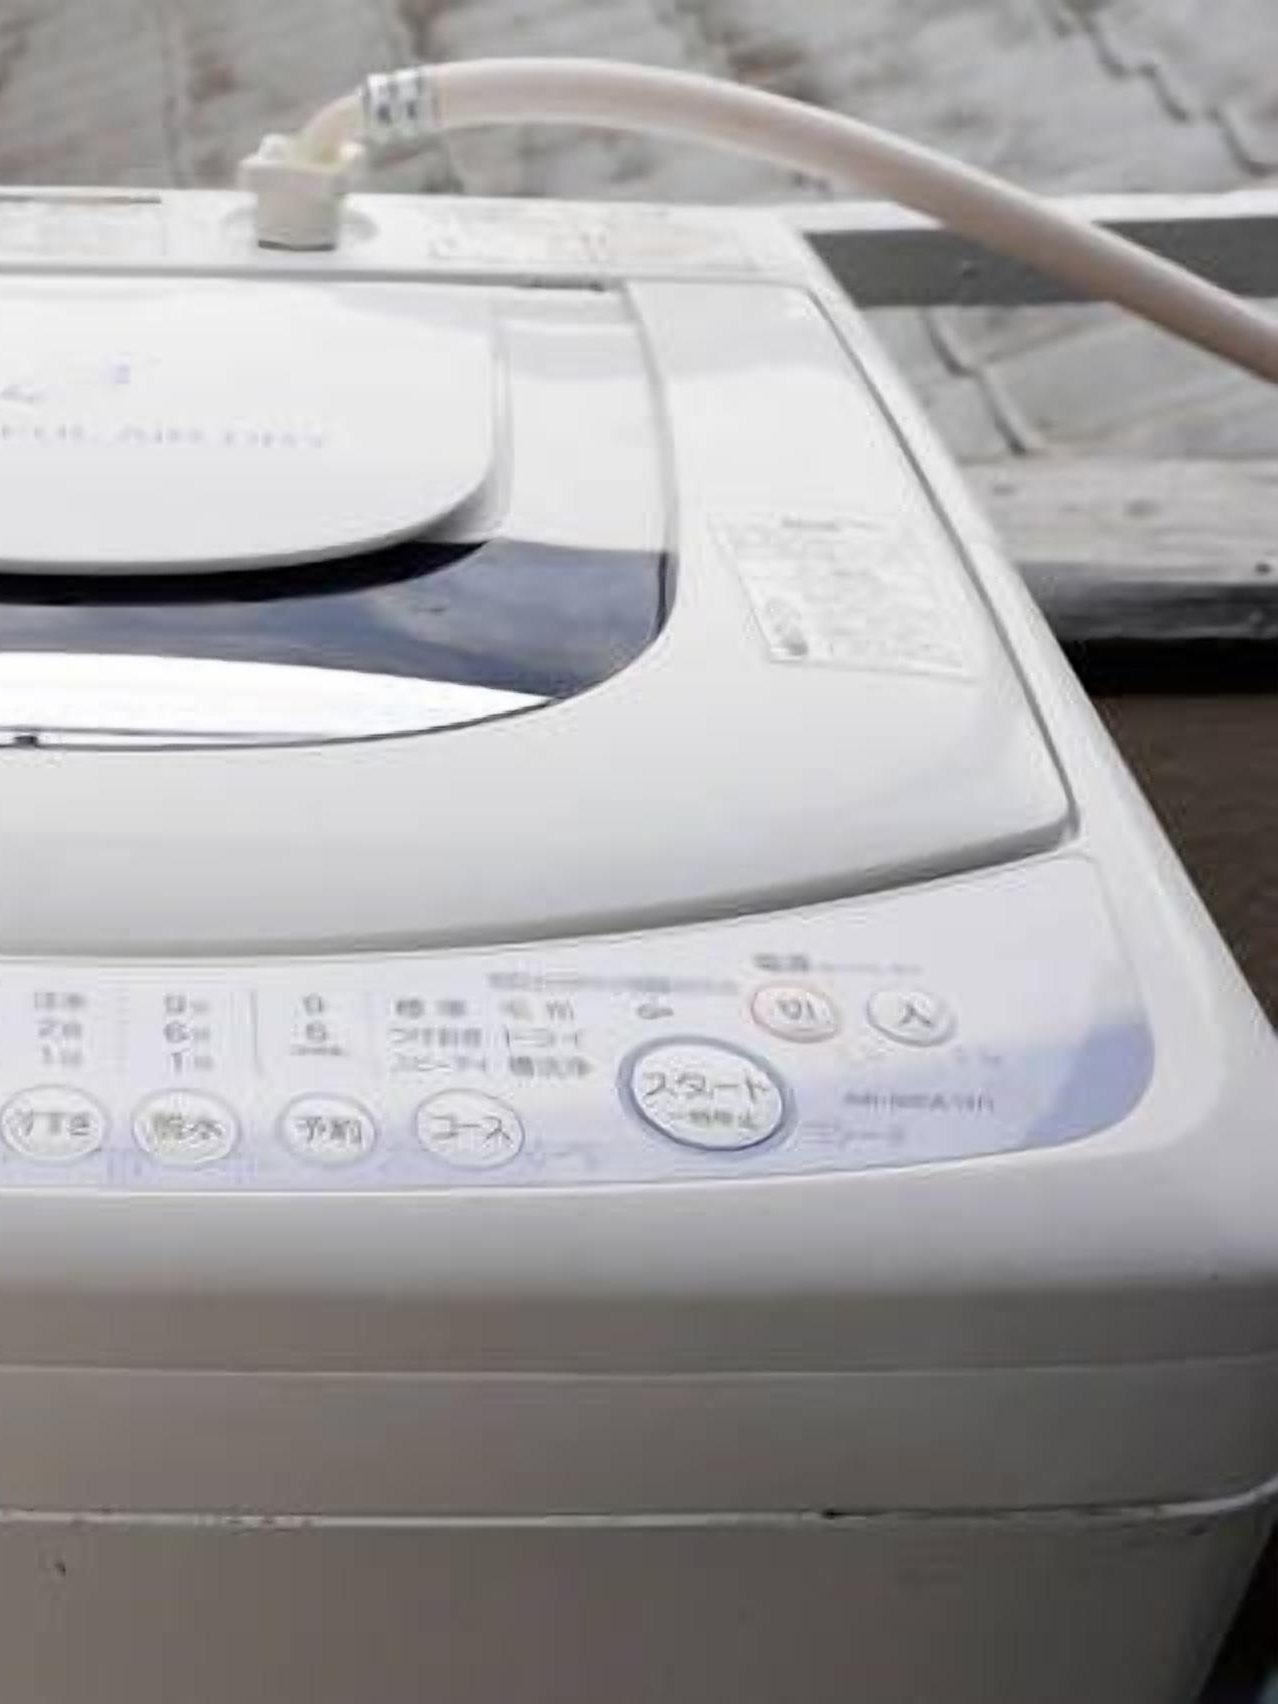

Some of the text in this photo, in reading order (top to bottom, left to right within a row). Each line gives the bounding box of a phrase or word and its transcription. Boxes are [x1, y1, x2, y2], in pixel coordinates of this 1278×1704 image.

[899, 1000, 936, 1028] 入
[642, 1069, 770, 1101] スタート
[430, 1113, 511, 1144] コース
